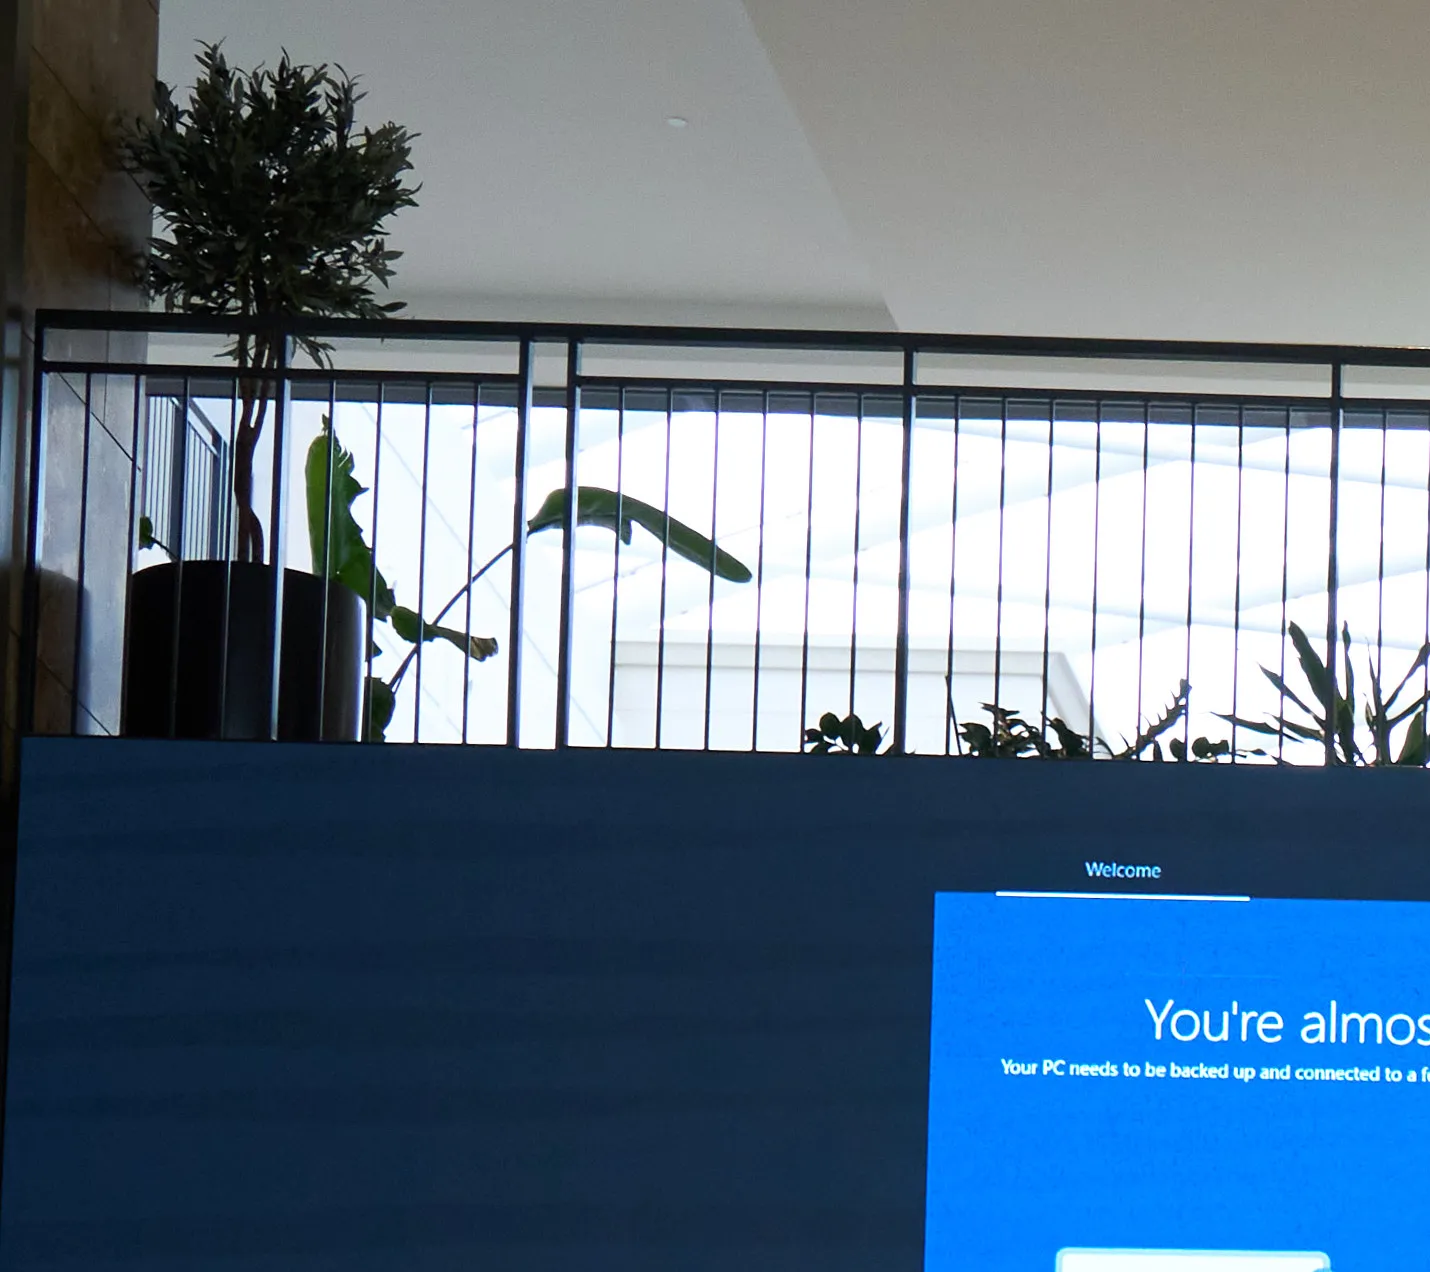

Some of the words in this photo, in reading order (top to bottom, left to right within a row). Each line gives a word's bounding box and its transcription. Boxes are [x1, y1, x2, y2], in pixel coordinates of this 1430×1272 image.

[1085, 862, 1162, 879] Welcome
[1144, 998, 1284, 1044] You're
[1001, 1058, 1038, 1075] Your
[1042, 1059, 1066, 1076] PC
[1069, 1061, 1119, 1077] needs
[1123, 1062, 1141, 1077] to
[1144, 1061, 1167, 1078] be
[1169, 1062, 1229, 1079] backed
[1233, 1067, 1257, 1083] up
[1259, 1064, 1291, 1080] and
[1294, 1066, 1381, 1082] connected
[1384, 1067, 1403, 1083] to
[1406, 1070, 1418, 1083] a
